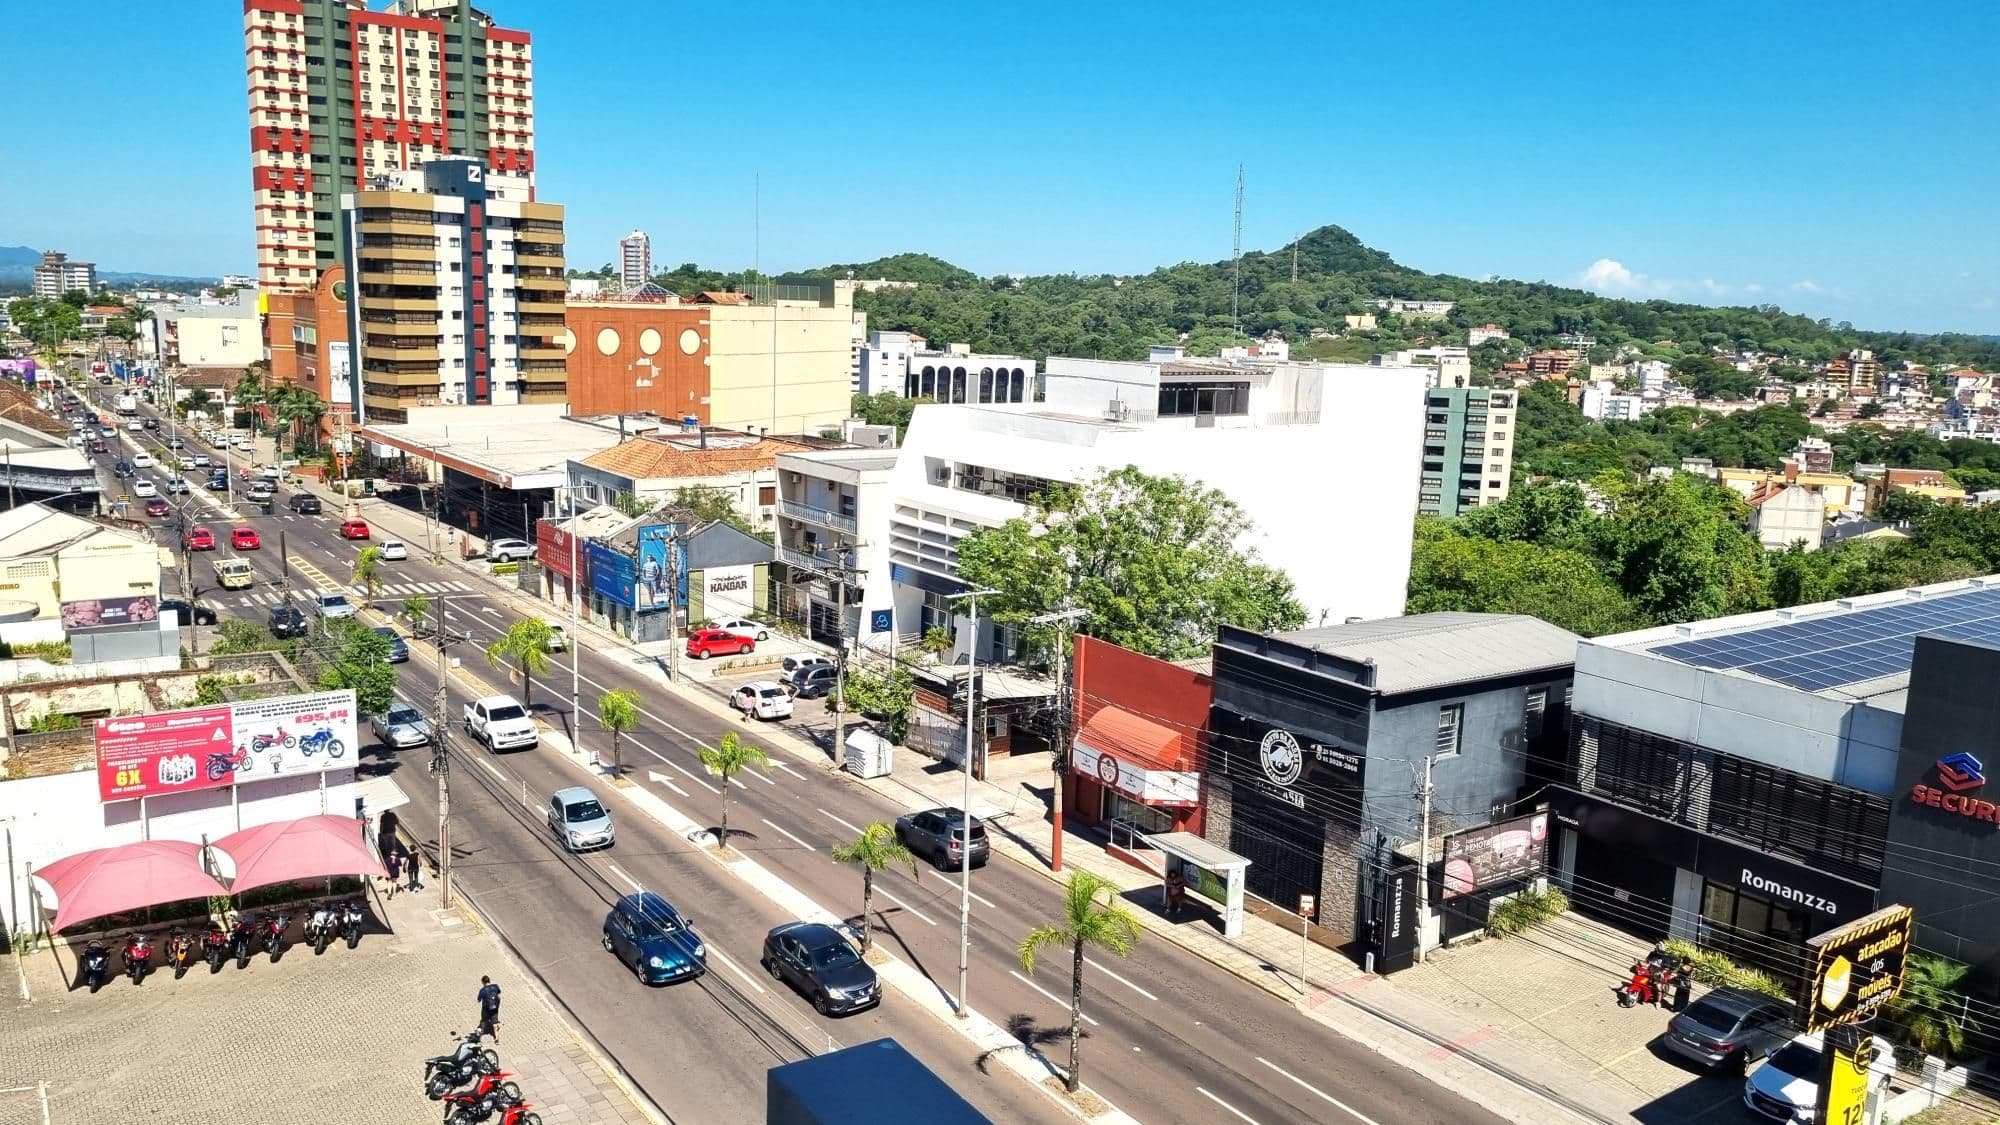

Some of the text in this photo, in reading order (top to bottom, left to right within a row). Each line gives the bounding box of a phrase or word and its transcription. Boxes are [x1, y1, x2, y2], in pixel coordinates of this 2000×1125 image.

[710, 580, 748, 593] HANGAR
[115, 769, 142, 787] 6X
[1741, 868, 1837, 915] Romanzza
[1391, 877, 1403, 938] Romanzza
[1857, 928, 1903, 962] atacadão
[1870, 957, 1885, 974] dos
[1858, 971, 1893, 1000] móveis
